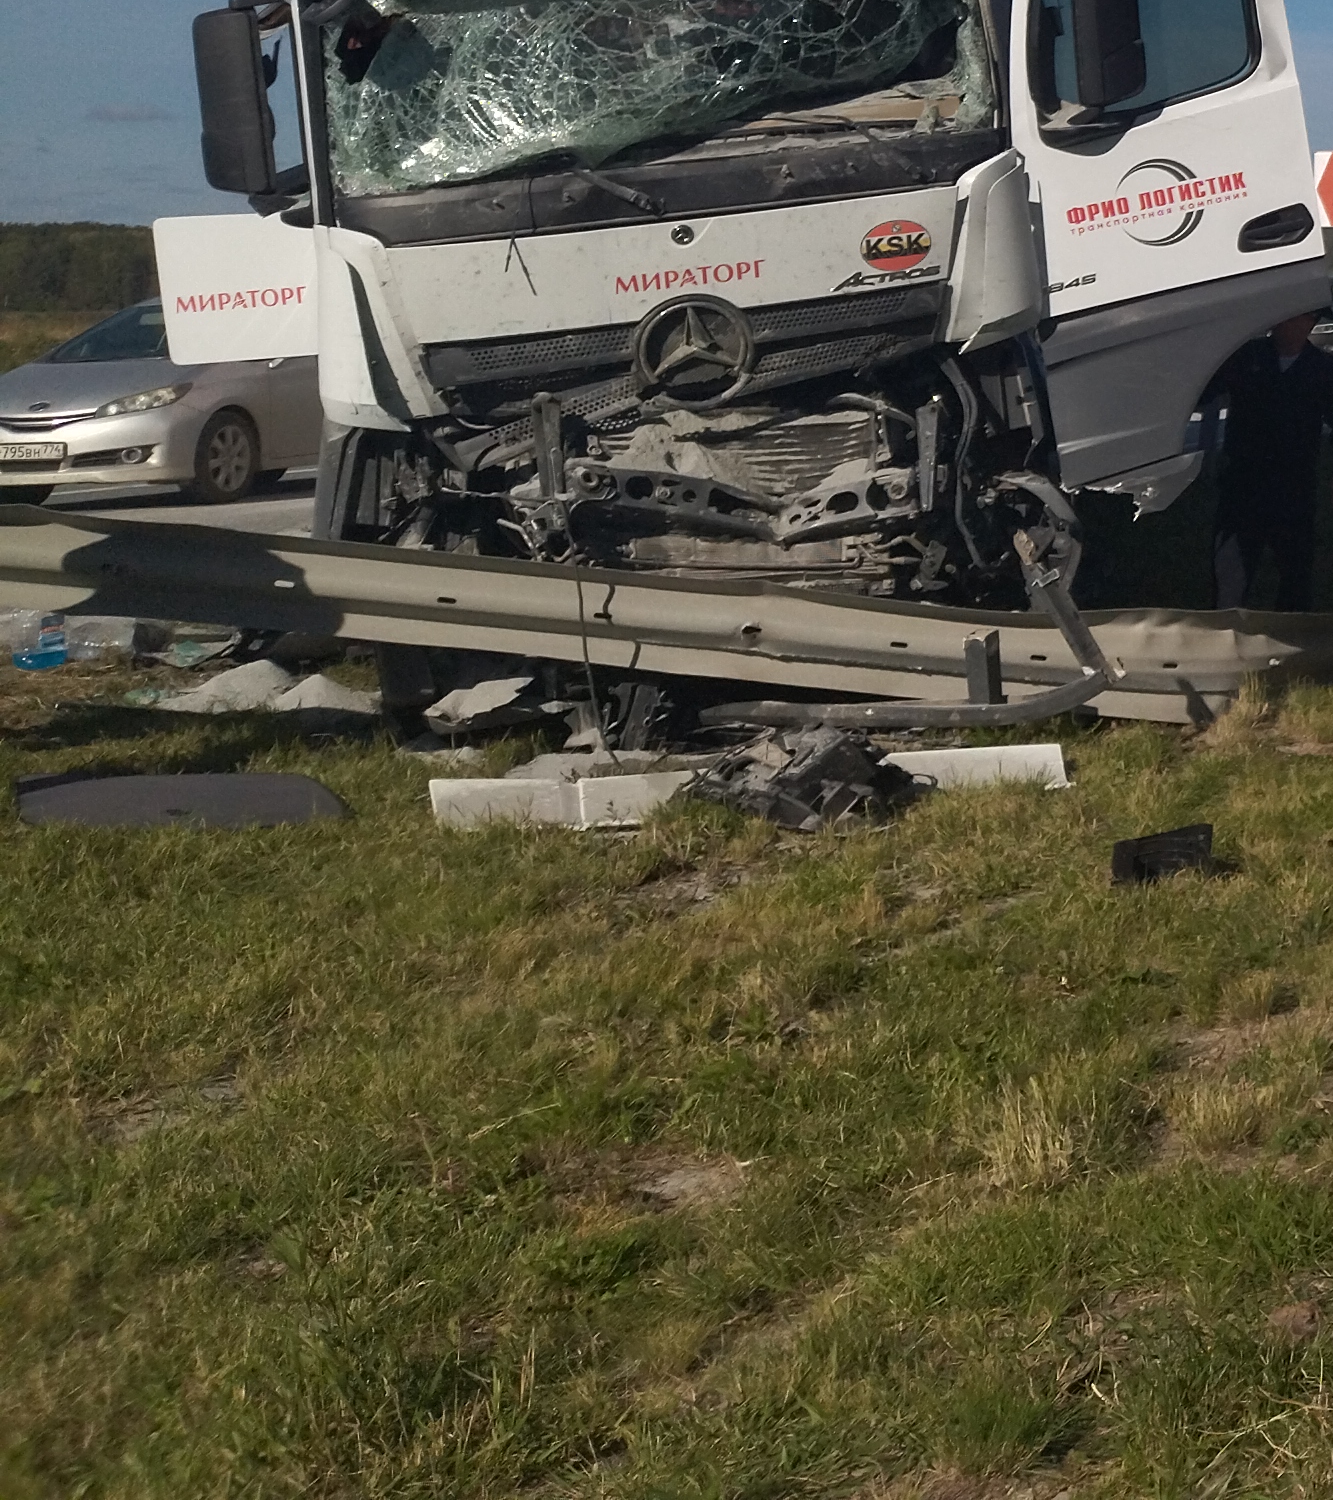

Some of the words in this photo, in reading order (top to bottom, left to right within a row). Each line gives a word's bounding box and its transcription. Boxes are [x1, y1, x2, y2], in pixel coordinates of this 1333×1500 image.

[1066, 197, 1130, 225] ФРИО
[1070, 208, 1172, 236] транспортная
[1179, 191, 1248, 211] компания
[615, 259, 766, 295] МИРАТОРГ
[176, 286, 307, 314] МИРАТОРГ
[0, 445, 40, 459] 795ВН
